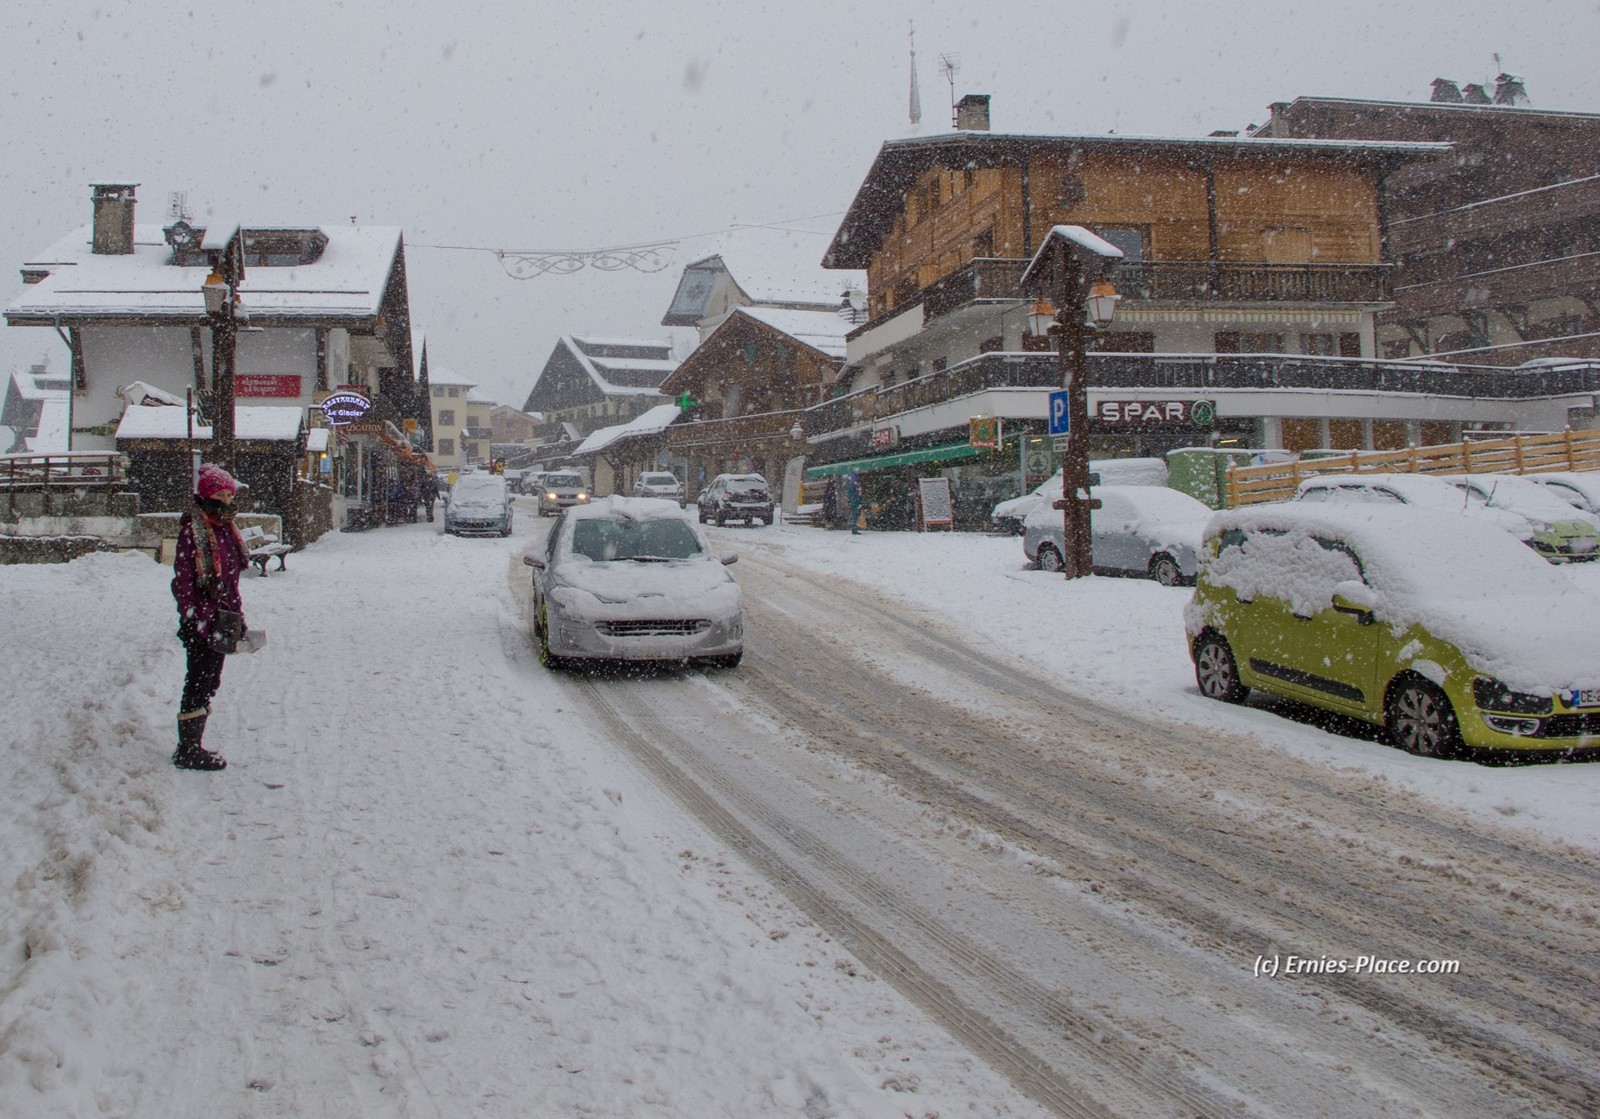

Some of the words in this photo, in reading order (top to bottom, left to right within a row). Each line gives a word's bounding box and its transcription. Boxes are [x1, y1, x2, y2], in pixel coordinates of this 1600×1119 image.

[338, 409, 364, 417] Glacier
[1053, 399, 1064, 427] P
[1102, 402, 1184, 421] SPAR
[346, 424, 382, 432] LOCATION
